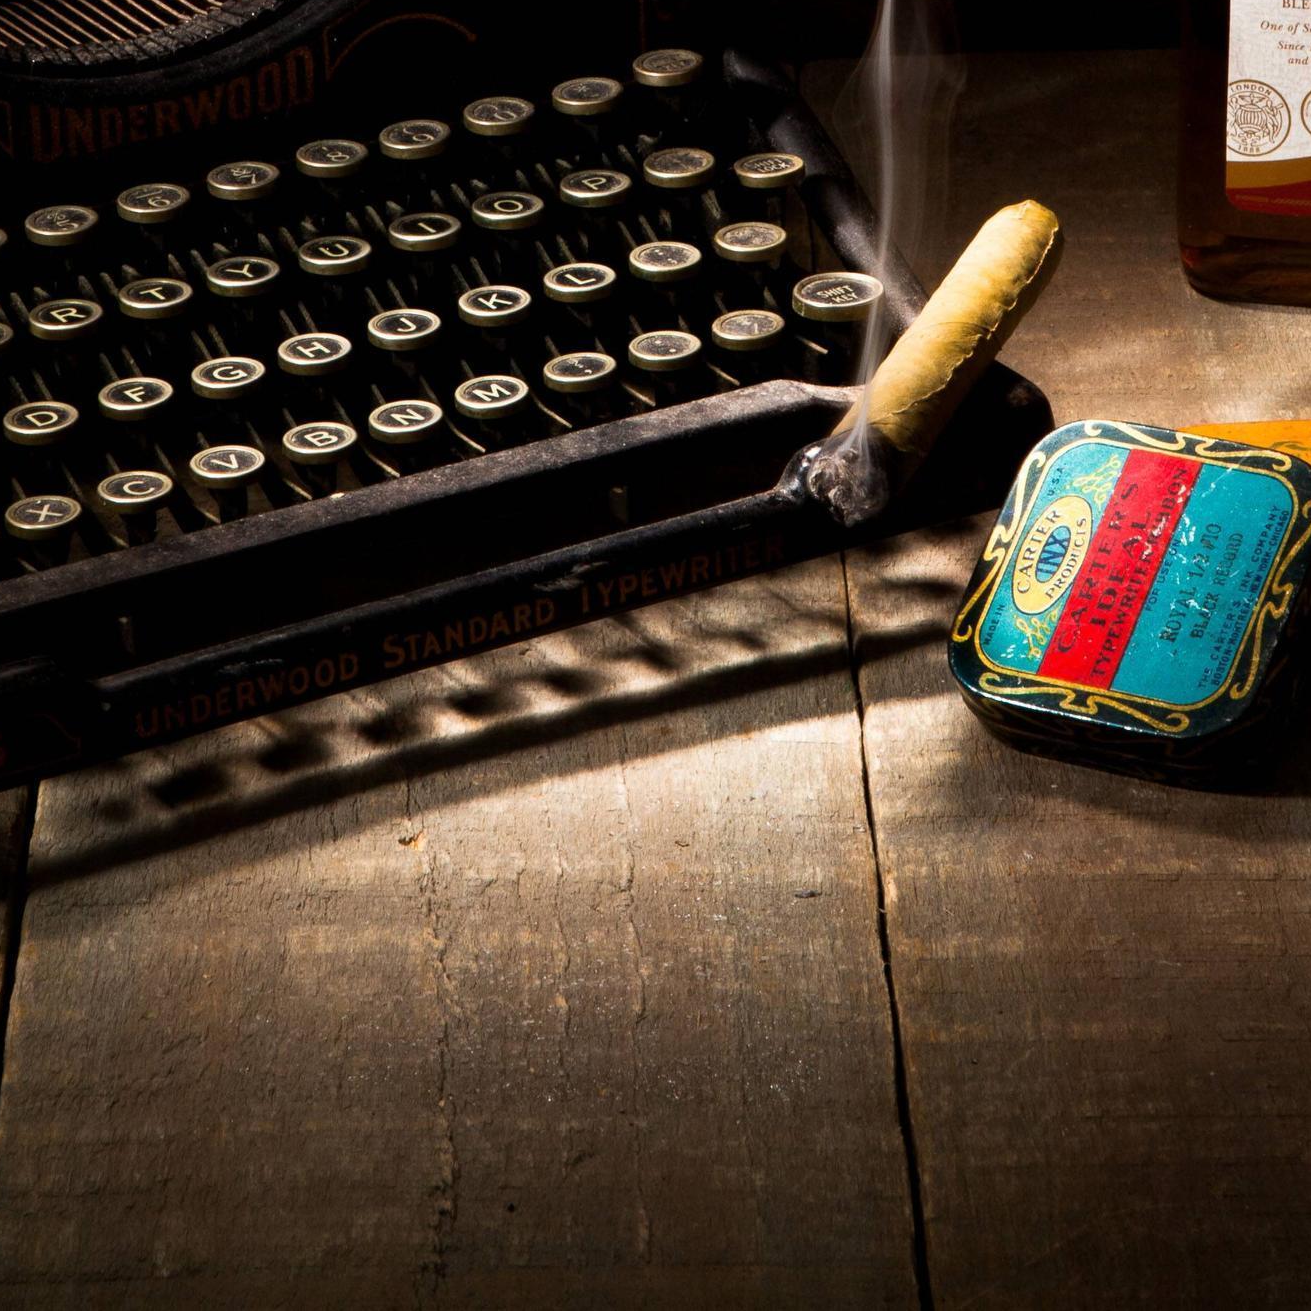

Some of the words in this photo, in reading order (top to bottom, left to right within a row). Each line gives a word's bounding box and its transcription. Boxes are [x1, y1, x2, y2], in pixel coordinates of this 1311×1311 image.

[1260, 19, 1284, 31] One
[1287, 21, 1300, 34] of
[1278, 40, 1306, 52] Since
[1287, 55, 1309, 66] and
[1230, 83, 1273, 96] LONDON
[25, 46, 316, 164] UNDERWOOD
[580, 177, 607, 191] P
[493, 197, 524, 214] O
[324, 243, 353, 259] U
[227, 263, 262, 281] Y
[563, 272, 597, 286] L
[140, 285, 167, 301] T
[478, 292, 512, 311] K
[815, 284, 852, 300] SHIFT
[831, 292, 860, 305] KEY
[50, 307, 87, 323] R
[394, 315, 420, 334] J
[300, 341, 333, 358] H
[211, 365, 249, 383] G
[122, 386, 147, 403] F
[472, 383, 514, 404] M
[24, 409, 59, 428] D
[389, 406, 422, 426] N
[303, 429, 343, 448] B
[209, 453, 240, 471] V
[122, 480, 156, 497] C
[25, 503, 65, 522] X
[1017, 509, 1062, 595] CARTER
[1036, 531, 1072, 576] INX
[1045, 516, 1088, 599] PRODUCTS
[1058, 483, 1139, 654] CARTER'S
[1091, 512, 1153, 628] IDEAL
[1145, 588, 1161, 612] FOR
[1157, 560, 1173, 587] USE
[1169, 539, 1182, 557] ON
[1190, 593, 1220, 640] BLACK
[1216, 532, 1245, 588] RECORD
[1198, 666, 1212, 691] THE
[1251, 505, 1282, 563] COMPANY
[1091, 544, 1153, 678] TYPEWRITER
[1160, 586, 1198, 644] ROYAL
[983, 616, 1001, 647] MADE
[997, 603, 1005, 616] IN
[135, 654, 362, 739] UNDERWOOD
[382, 595, 557, 670] STANDARD
[576, 534, 786, 618] TYPEWRITER
